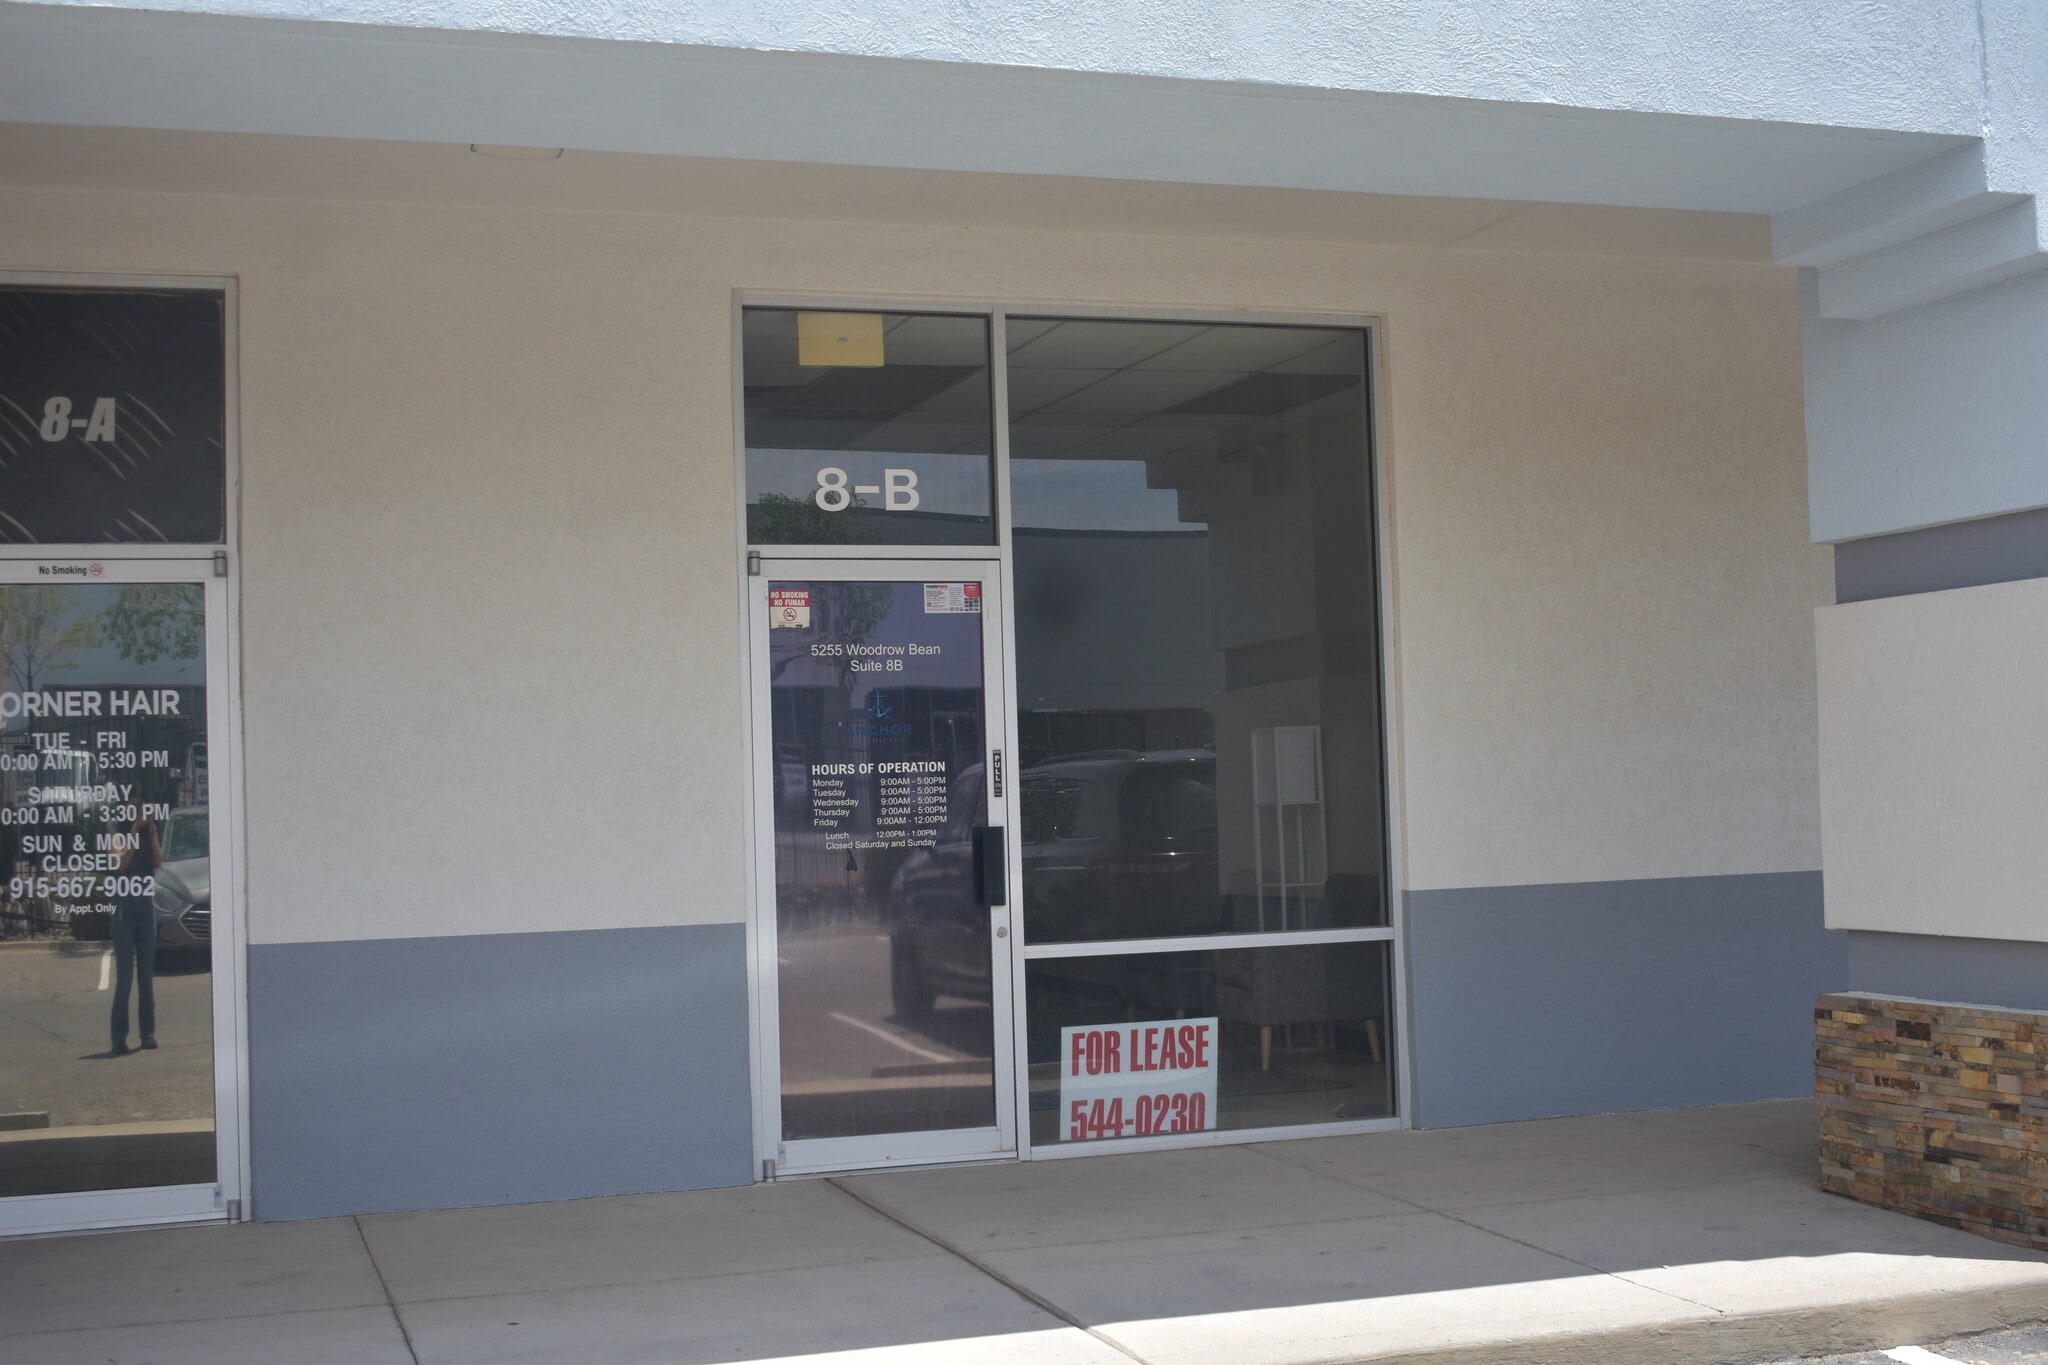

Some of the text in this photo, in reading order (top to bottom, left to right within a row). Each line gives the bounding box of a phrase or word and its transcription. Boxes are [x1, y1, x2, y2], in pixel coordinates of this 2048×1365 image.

[40, 396, 116, 442] 8-A
[815, 467, 920, 512] 8-B
[39, 565, 87, 576] No Smoking
[811, 643, 940, 656] 5255 Woodrow Bean
[850, 659, 903, 671] Suite 8B
[110, 690, 180, 716] HAIR
[32, 733, 70, 750] TUE
[97, 732, 127, 749] FRI
[44, 753, 72, 770] AM
[99, 752, 136, 769] 5:30
[141, 751, 168, 768] PM
[812, 761, 945, 775] HOURS OF OPERATION
[813, 779, 843, 788] Monday
[880, 778, 909, 786] 9:00AM
[917, 777, 946, 785] 5:00PM
[28, 785, 133, 804] SATURDAY
[813, 789, 846, 798] Tuesday
[880, 788, 910, 796] 9:00AM
[917, 787, 946, 795] 5:00PM
[813, 798, 859, 807] Wednesday
[881, 797, 910, 805] 9:00AM
[917, 796, 946, 804] 5:00PM
[44, 806, 73, 824] AM
[100, 805, 137, 822] 3:30
[142, 803, 169, 821] PM
[814, 809, 850, 817] Thursday
[881, 807, 911, 815] 9:00AM
[918, 806, 947, 814] 5:00PM
[814, 819, 838, 828] Friday
[876, 817, 907, 825] 9:00AM
[914, 816, 947, 824] 12:00PM
[825, 832, 849, 840] Lunch
[912, 829, 936, 837] 1:00PM
[22, 833, 139, 853] SUN & MON
[826, 841, 852, 850] Closed
[855, 840, 889, 849] Saturday
[908, 839, 936, 848] Sunday
[42, 854, 121, 872] CLOSED
[10, 876, 156, 899] 915-667-9062
[55, 903, 117, 915] By Appt. Only
[1072, 1025, 1209, 1076] FOR LEASE
[1071, 1092, 1205, 1140] 544-0230
